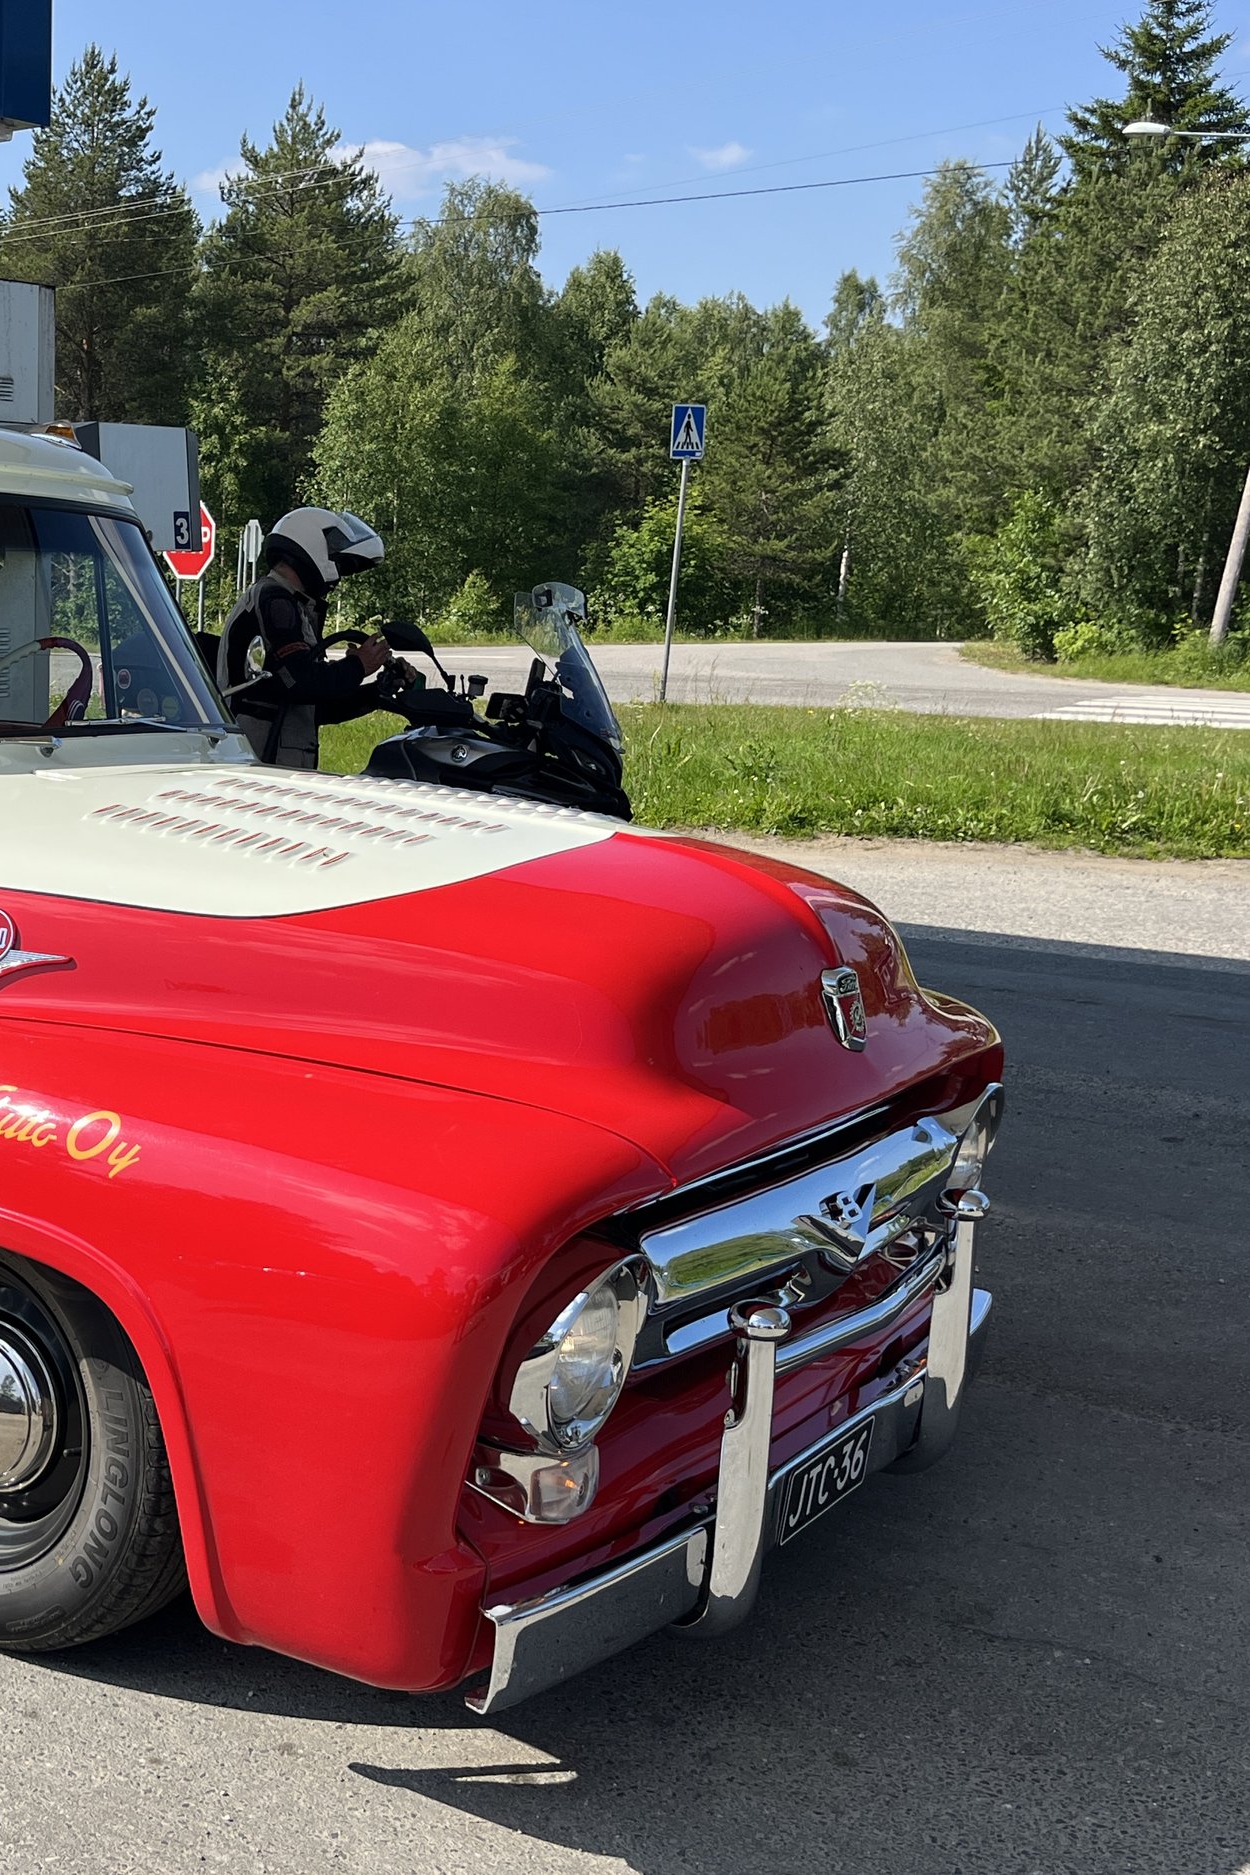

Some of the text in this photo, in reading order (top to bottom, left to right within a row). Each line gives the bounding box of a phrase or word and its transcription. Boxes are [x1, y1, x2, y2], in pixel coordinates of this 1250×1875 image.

[175, 518, 190, 545] 3
[66, 1110, 141, 1178] Oy
[68, 1387, 129, 1589] LINGLONG
[788, 1429, 868, 1528] JTC-36
